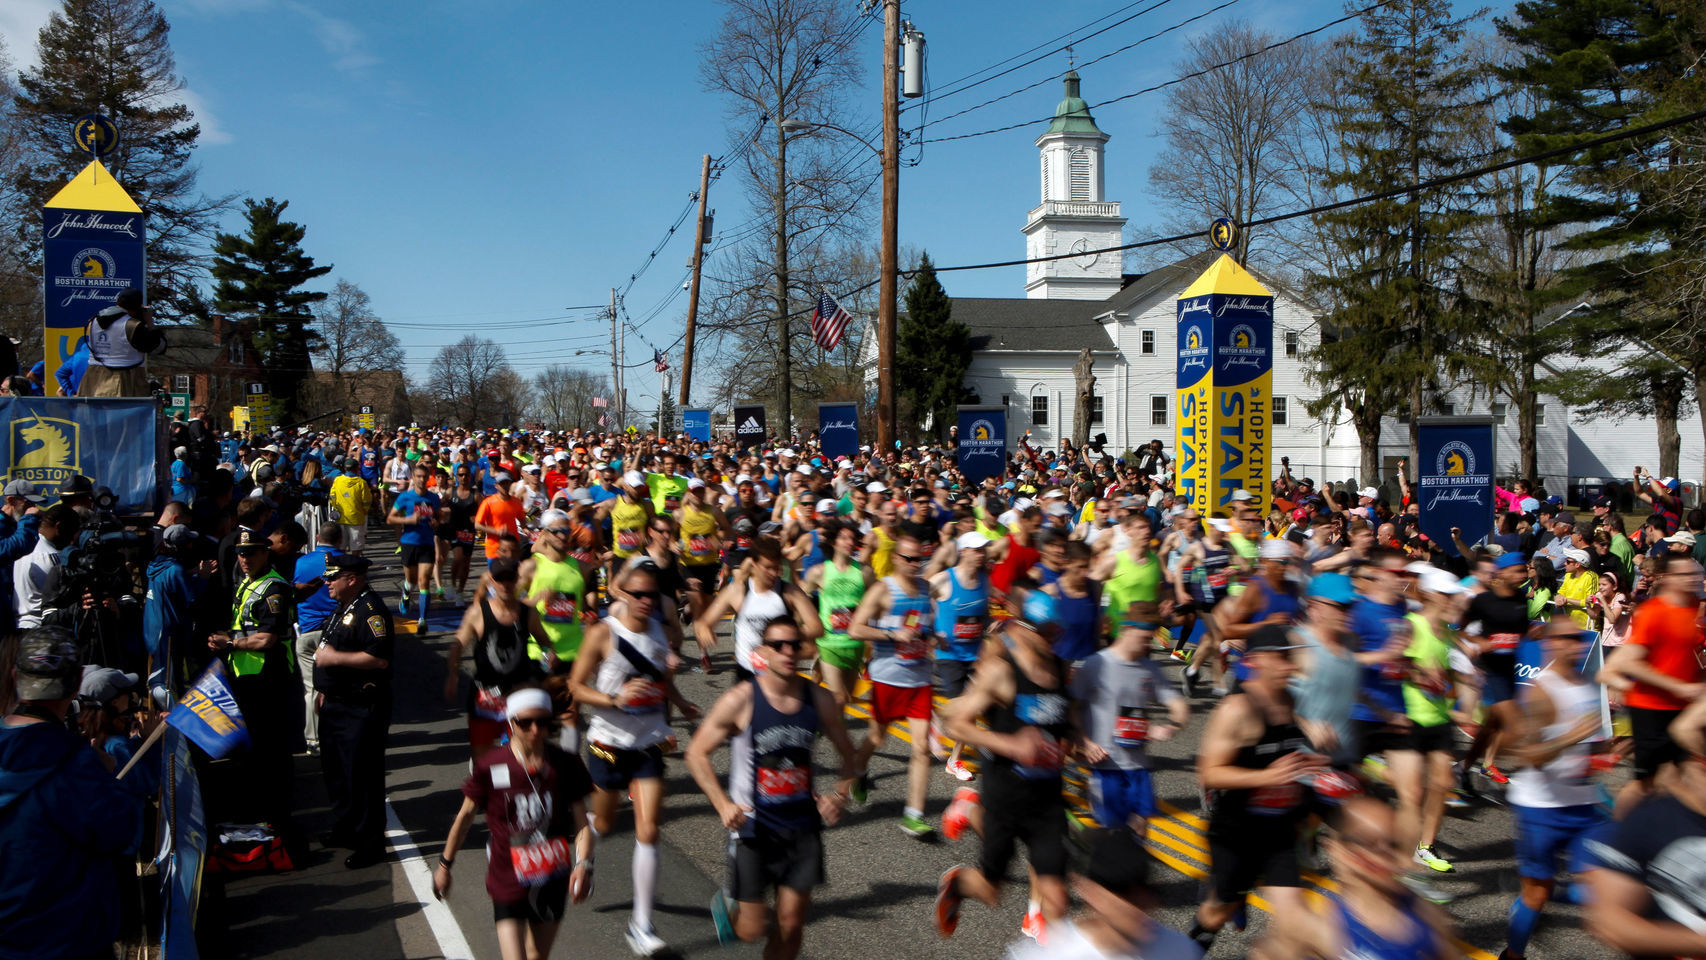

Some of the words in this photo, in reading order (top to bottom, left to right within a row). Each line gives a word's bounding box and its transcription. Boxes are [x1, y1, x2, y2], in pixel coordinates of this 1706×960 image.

[47, 212, 84, 239] John
[82, 212, 138, 239] Hancock
[55, 278, 86, 286] BOSTON
[88, 279, 131, 287] MARATHON
[61, 288, 87, 307] John
[1216, 296, 1239, 318] John
[1237, 296, 1271, 317] Hancock
[254, 384, 260, 393] 1
[1181, 392, 1196, 505] STAR
[1219, 391, 1244, 507] STAR
[1198, 401, 1208, 519] HOPKINTON
[15, 468, 73, 480] BOSTON
[1421, 477, 1449, 486] BOSTON
[1450, 476, 1489, 485] MARATHON
[1426, 489, 1450, 511] John
[1448, 488, 1483, 506] Hancock
